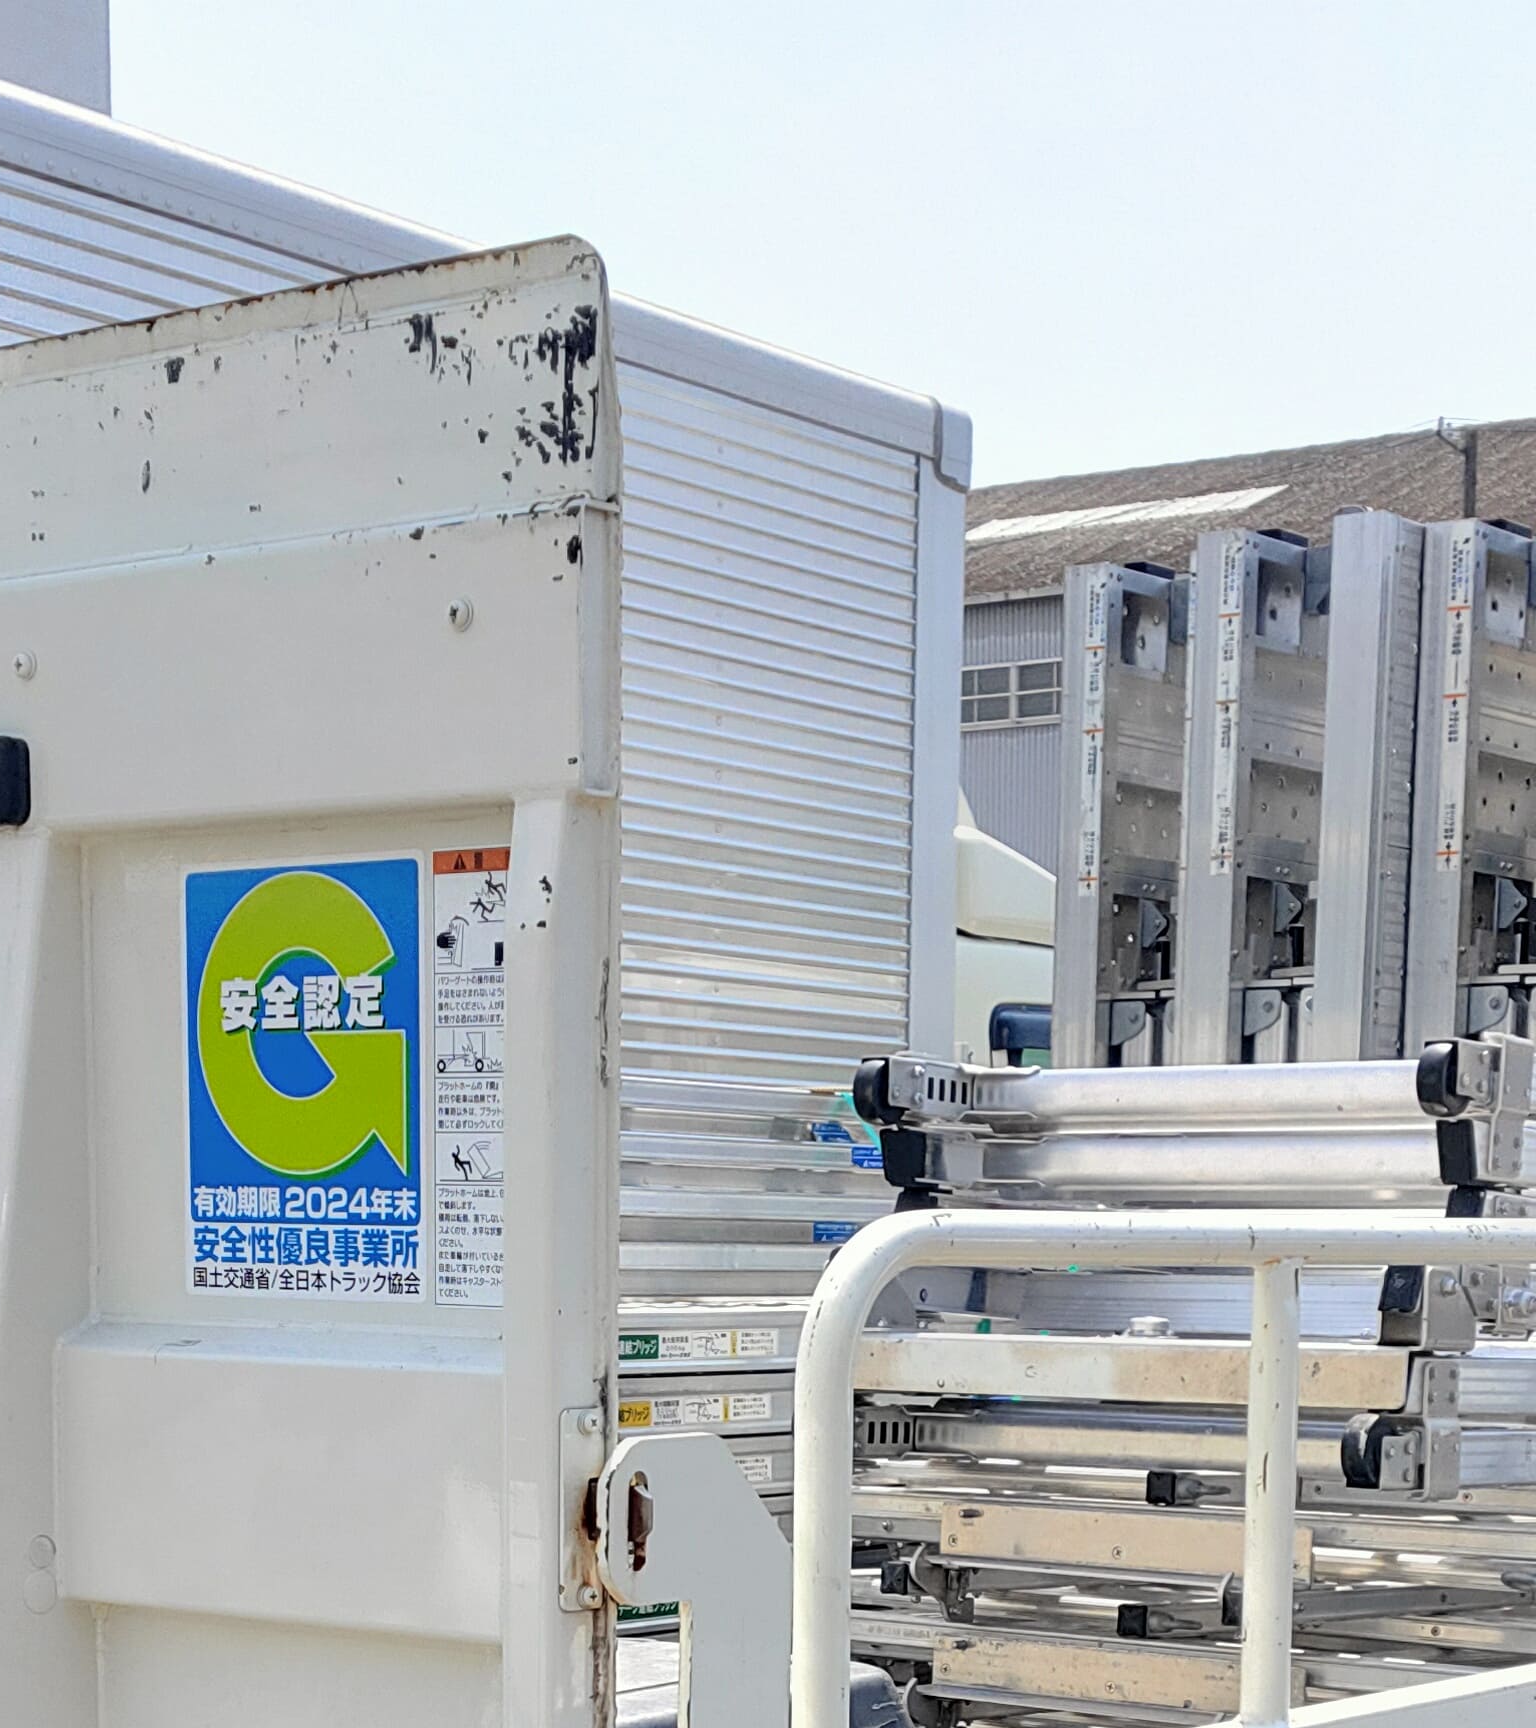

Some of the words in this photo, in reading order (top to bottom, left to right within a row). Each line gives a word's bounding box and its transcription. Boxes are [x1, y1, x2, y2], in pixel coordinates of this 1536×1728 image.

[219, 973, 386, 1032] 安全認定
[193, 1185, 281, 1219] 有効期限
[284, 1186, 418, 1220] 2024年末
[193, 1226, 420, 1270] 安全性優良事業所
